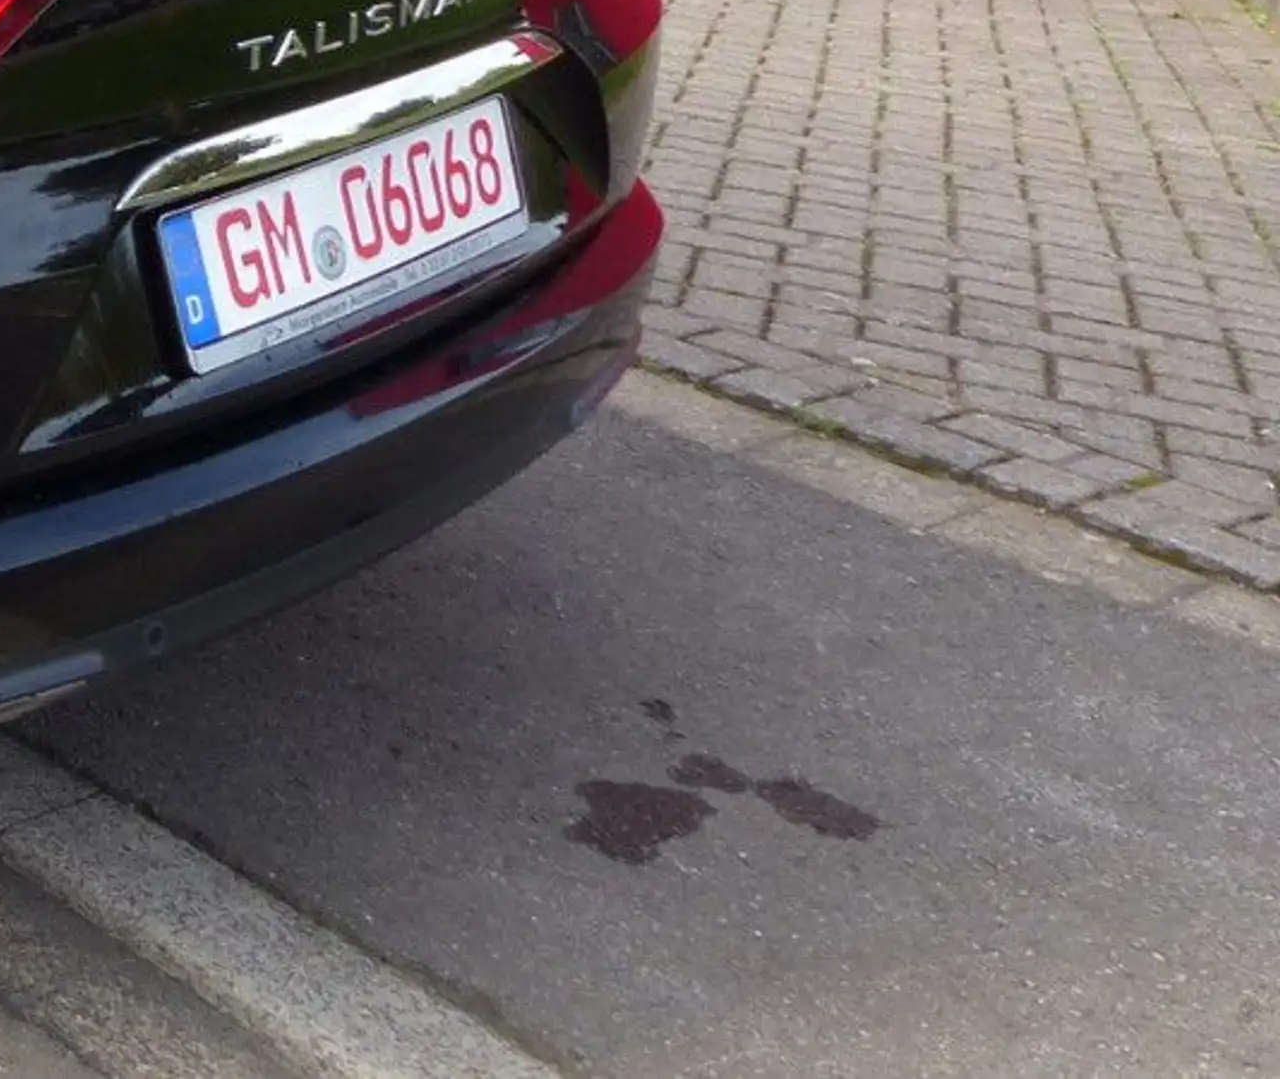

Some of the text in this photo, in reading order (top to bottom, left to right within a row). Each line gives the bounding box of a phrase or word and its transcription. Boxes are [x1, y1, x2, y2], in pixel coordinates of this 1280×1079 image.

[216, 118, 503, 309] GM 06068
[185, 294, 204, 324] D
